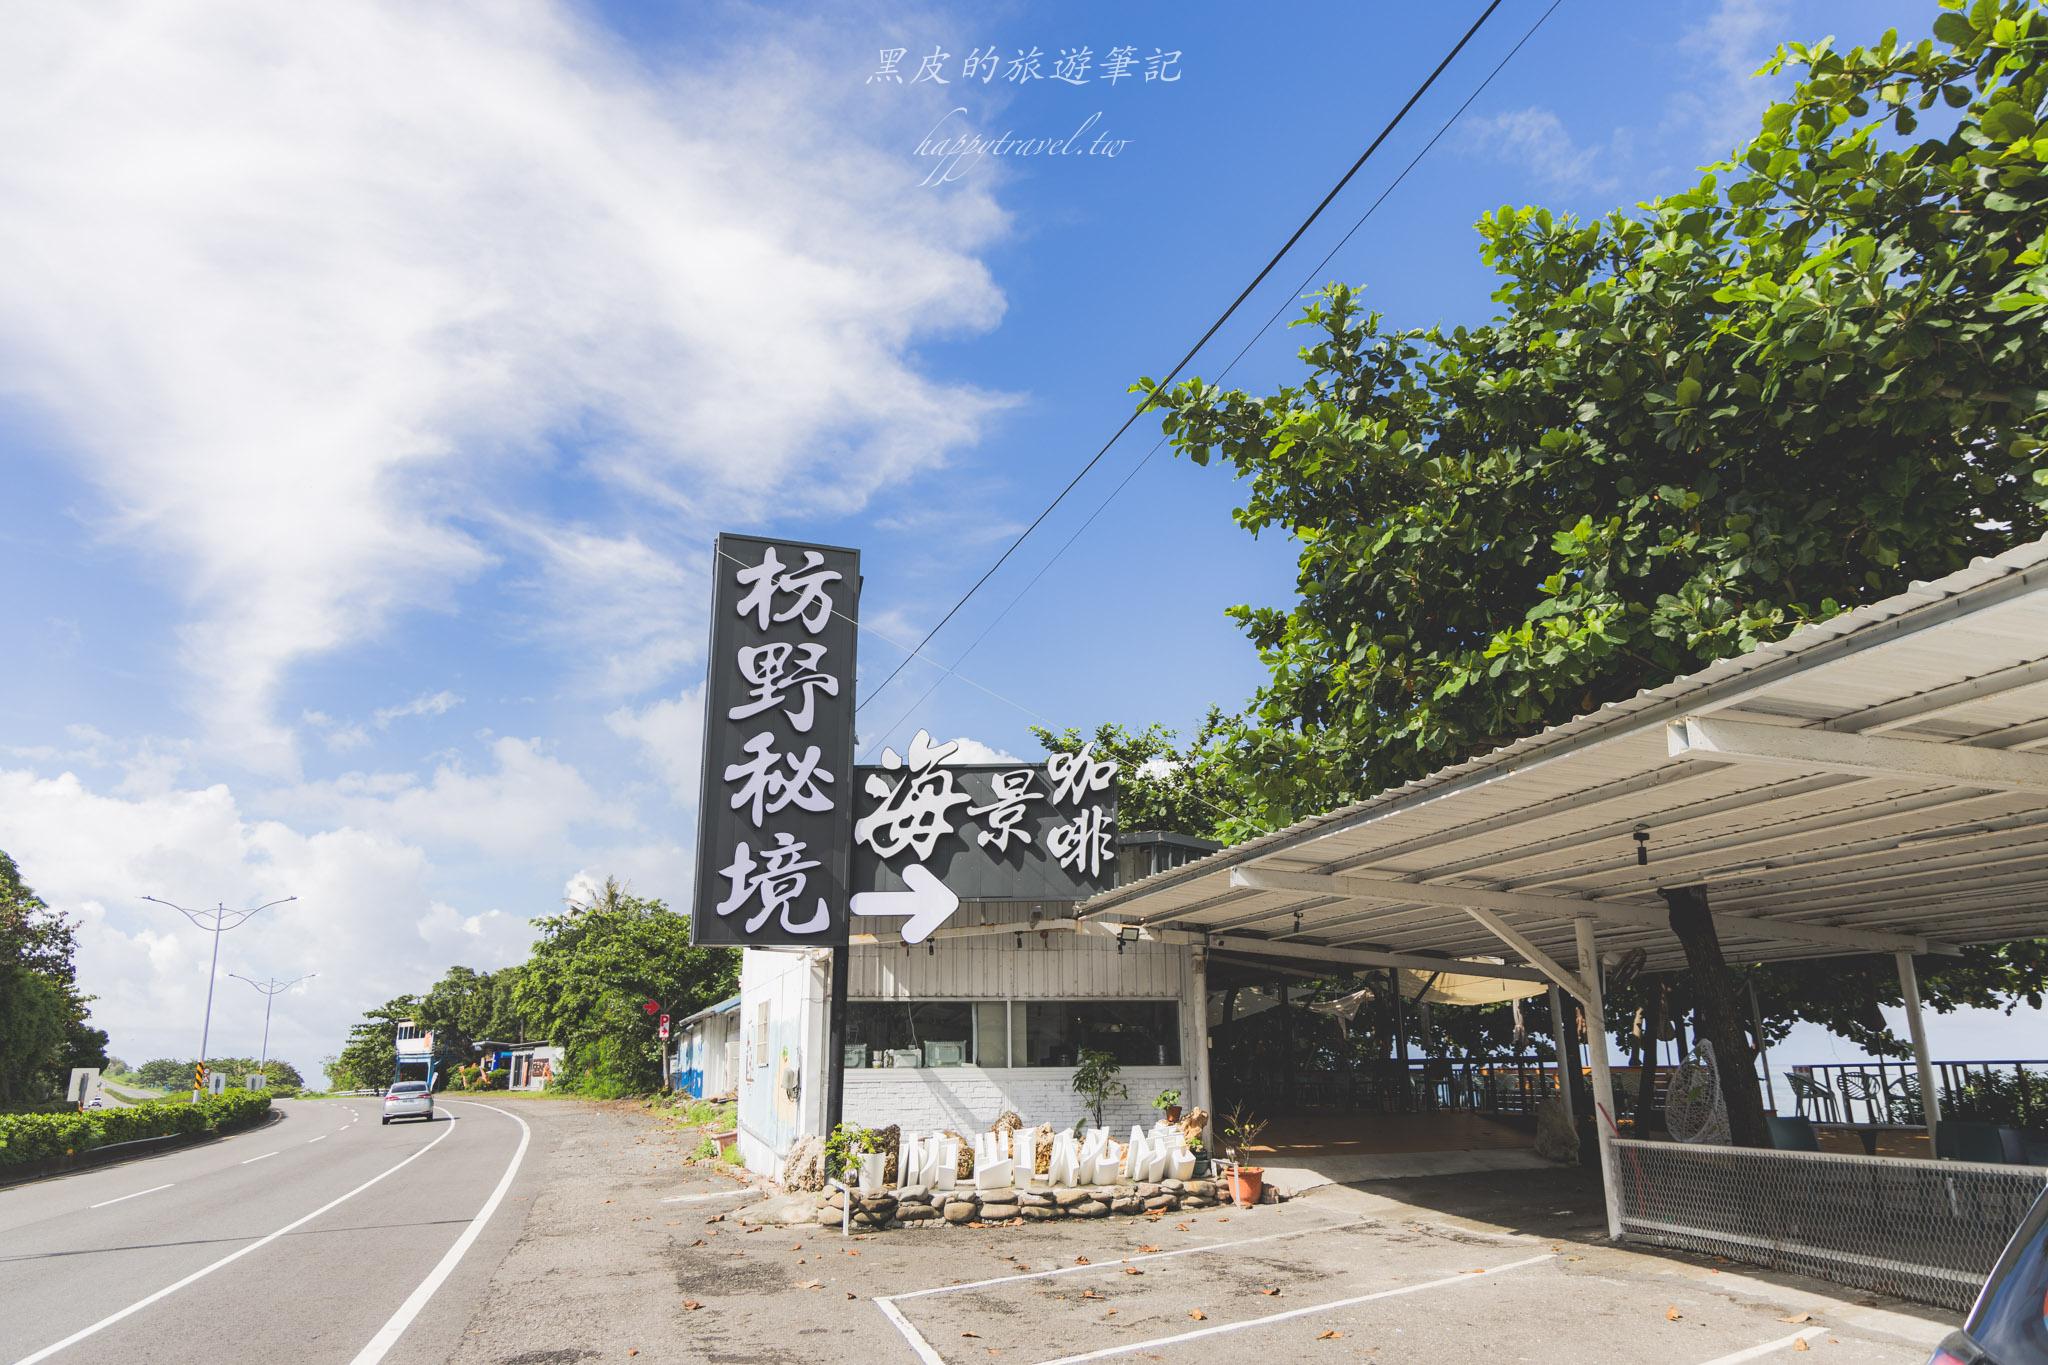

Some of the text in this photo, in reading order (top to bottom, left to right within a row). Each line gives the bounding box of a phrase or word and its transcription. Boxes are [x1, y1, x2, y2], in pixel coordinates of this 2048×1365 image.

[716, 546, 843, 934] 枋野秘境
[660, 1015, 669, 1027] P
